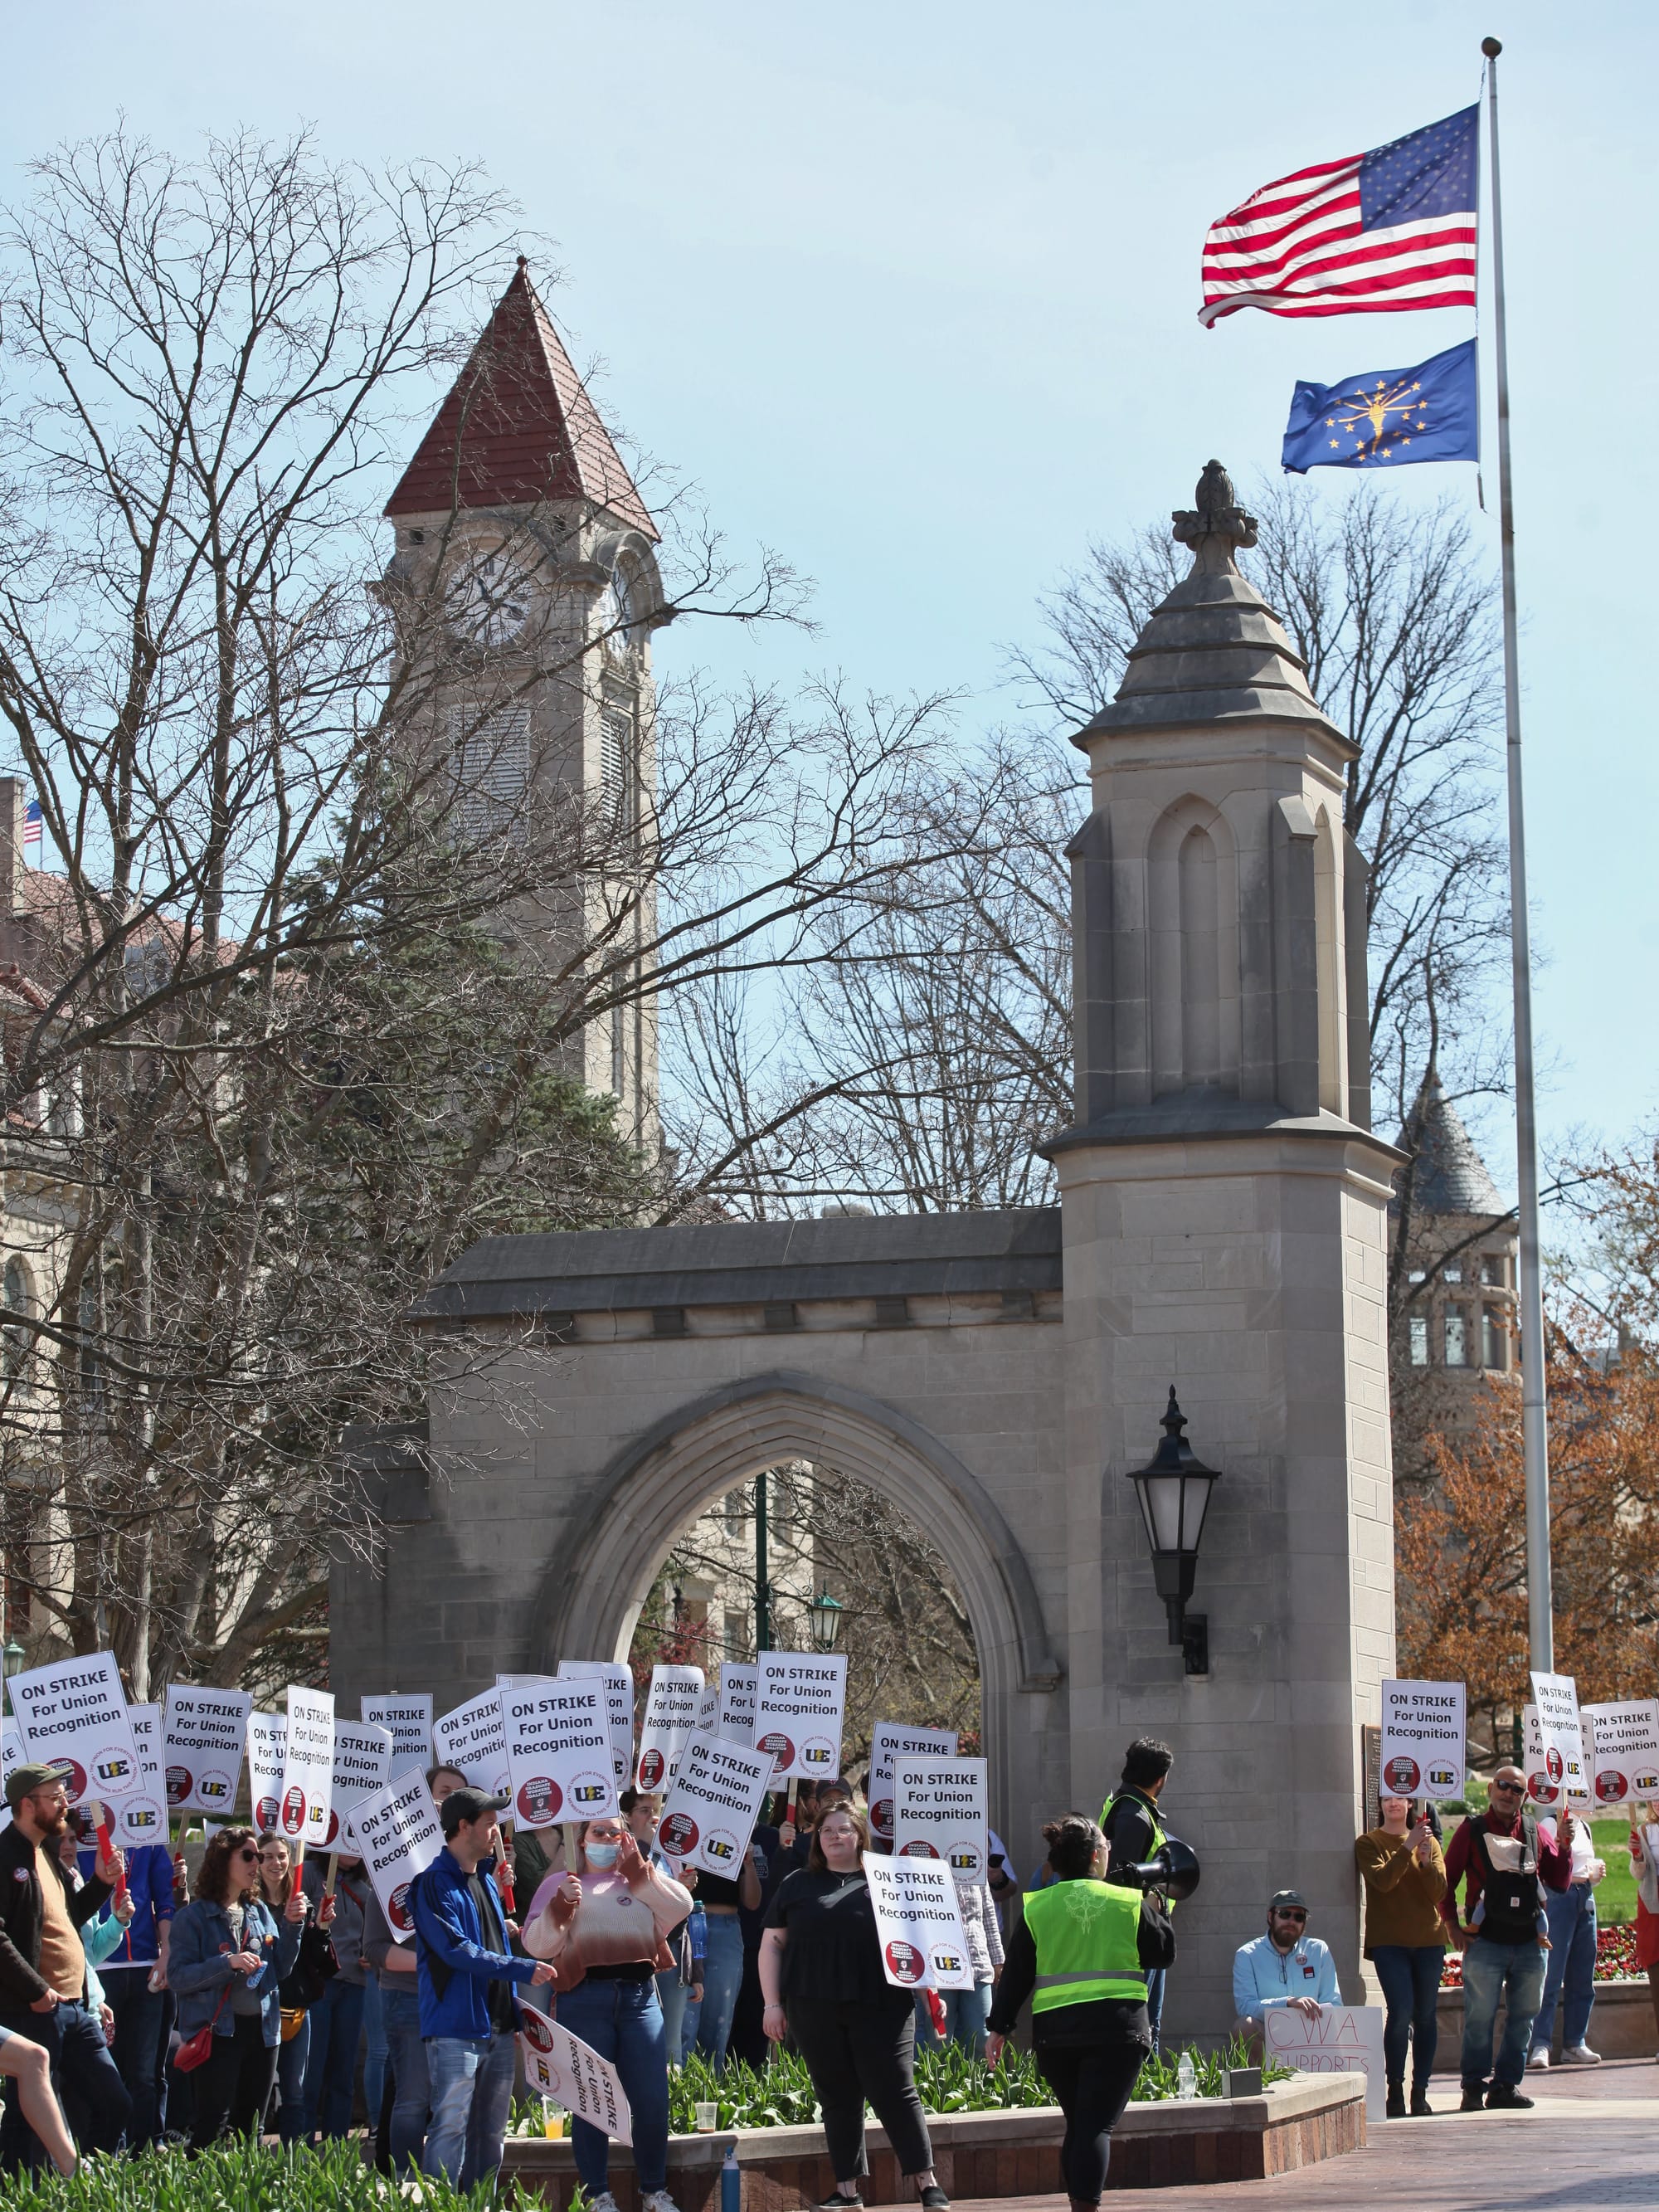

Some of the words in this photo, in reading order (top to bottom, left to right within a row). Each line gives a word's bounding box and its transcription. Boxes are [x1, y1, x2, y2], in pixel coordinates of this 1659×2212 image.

[766, 1667, 785, 1678] ON
[789, 1668, 838, 1681] STRIKE
[22, 1684, 46, 1700] ON
[50, 1670, 108, 1693] STRIKE
[654, 1682, 664, 1693] ON
[667, 1682, 698, 1693] STRIKE
[727, 1678, 743, 1690] ON
[769, 1683, 791, 1695] For
[794, 1685, 832, 1698] Union
[730, 1696, 747, 1708] For
[1389, 1694, 1408, 1705] ON
[1412, 1695, 1457, 1708] STRIKE
[1538, 1686, 1549, 1697] ON
[1550, 1688, 1572, 1701] STRIKE
[32, 1703, 57, 1718] For
[61, 1692, 108, 1711] Union
[175, 1701, 194, 1713] ON
[197, 1703, 243, 1718] STRIKE
[511, 1703, 534, 1717] ON
[539, 1694, 596, 1713] STRIKE
[654, 1699, 667, 1710] For
[669, 1700, 693, 1711] Union
[761, 1701, 838, 1716] Recognition
[1543, 1702, 1554, 1713] For
[1554, 1703, 1573, 1716] Union
[27, 1708, 121, 1740] Recognition
[294, 1706, 304, 1719] ON
[306, 1708, 330, 1725] STRIKE
[368, 1711, 383, 1722] ON
[386, 1709, 426, 1722] STRIKE
[440, 1718, 460, 1734] ON
[461, 1700, 501, 1726] STRIK
[647, 1717, 695, 1730] Recognition
[1394, 1710, 1414, 1721] For
[1417, 1712, 1452, 1723] Union
[1610, 1713, 1652, 1725] STRIKE
[176, 1717, 197, 1729] For
[200, 1720, 235, 1734] Union
[519, 1723, 544, 1736] For
[547, 1716, 593, 1731] Union
[1387, 1726, 1458, 1740] Recognition
[1541, 1717, 1579, 1732] Recognition
[166, 1734, 239, 1751] Recognition
[253, 1728, 267, 1741] ON
[295, 1727, 307, 1741] For
[309, 1729, 328, 1745] Union
[1596, 1732, 1613, 1741] For
[1617, 1728, 1649, 1738] Union
[258, 1746, 273, 1758] For
[340, 1737, 385, 1754] STRIKE
[392, 1742, 427, 1756] gnition
[448, 1736, 468, 1751] For
[513, 1736, 604, 1756] Recognition
[880, 1737, 898, 1749] ON
[902, 1741, 949, 1755] STRIKE
[289, 1747, 330, 1766] Recognition
[445, 1738, 505, 1767] Recogniti
[343, 1756, 378, 1771] Union
[692, 1745, 709, 1761] ON
[711, 1752, 761, 1779] STRIKE
[333, 1775, 382, 1790] ognition
[688, 1763, 709, 1779] For
[712, 1771, 750, 1794] Union
[902, 1774, 923, 1785] ON
[927, 1774, 978, 1785] STRIKE
[677, 1778, 752, 1814] Recognition
[908, 1791, 930, 1802] For
[934, 1791, 973, 1802] Union
[361, 1815, 379, 1834] ON
[381, 1786, 422, 1818] STRIKE
[901, 1808, 980, 1822] Recognition
[372, 1831, 391, 1850] For
[393, 1808, 425, 1836] Union
[372, 1822, 437, 1873] Recognition
[873, 1869, 891, 1883] ON
[894, 1873, 945, 1885] STRIKE
[881, 1888, 901, 1901] For
[905, 1890, 944, 1903] Union
[878, 1905, 955, 1922] Recognition
[1267, 2011, 1360, 2047] CWA
[583, 2053, 594, 2075] For
[596, 2059, 610, 2078] ON
[567, 2037, 587, 2113] Recognition
[588, 2077, 601, 2114] Union
[602, 2079, 617, 2130] STRIKE
